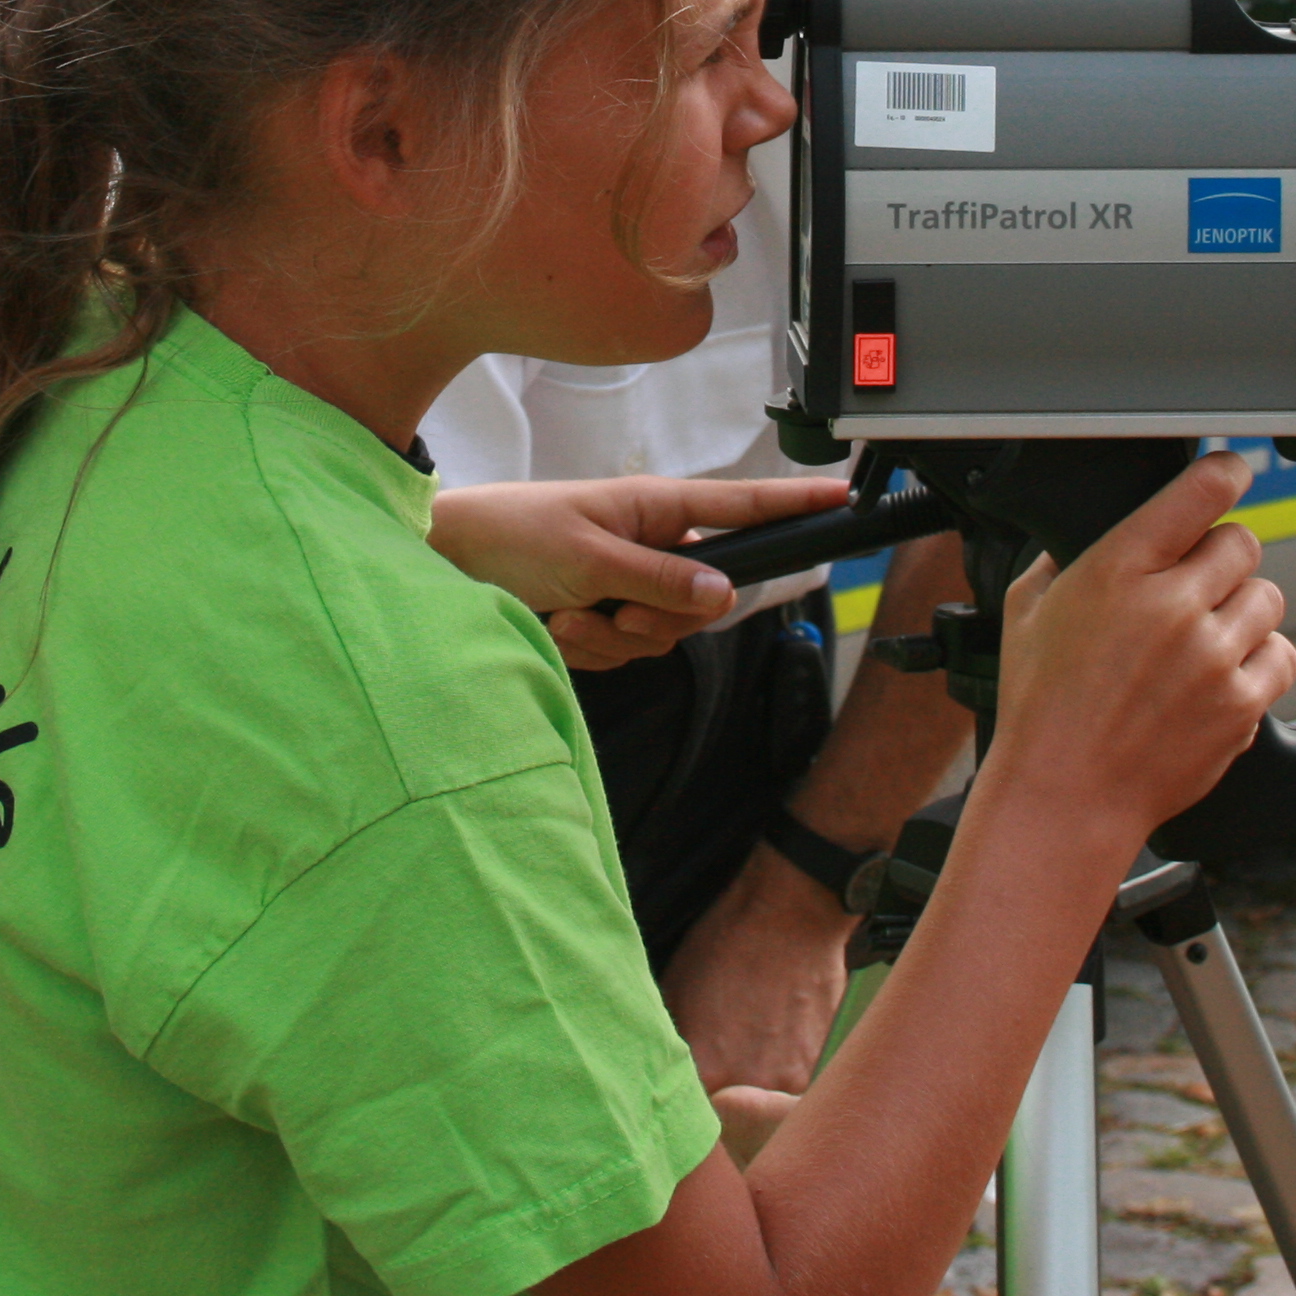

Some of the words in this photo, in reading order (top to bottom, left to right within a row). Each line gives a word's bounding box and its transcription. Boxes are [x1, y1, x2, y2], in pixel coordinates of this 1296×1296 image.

[887, 201, 1077, 231] TraffiPatrol
[1088, 202, 1134, 231] XR
[1194, 227, 1275, 245] JENOPTIK
